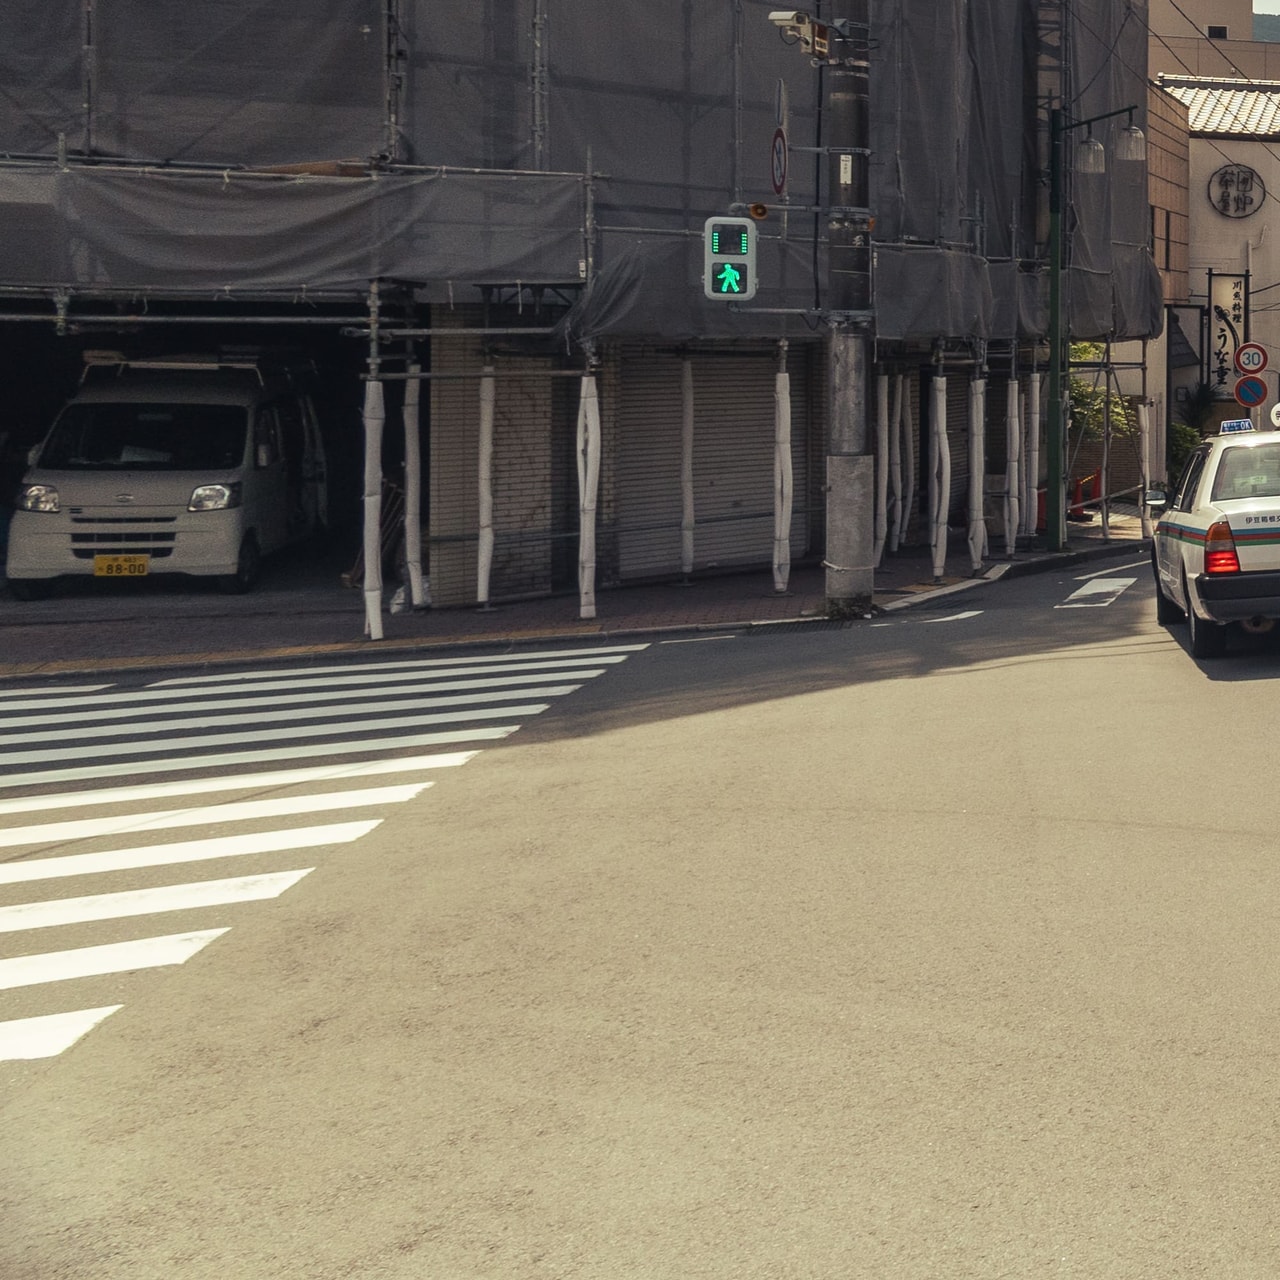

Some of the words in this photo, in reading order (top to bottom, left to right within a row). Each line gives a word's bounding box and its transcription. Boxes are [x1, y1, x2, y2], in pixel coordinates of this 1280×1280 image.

[1212, 327, 1232, 385] うな重
[1242, 351, 1261, 366] 30
